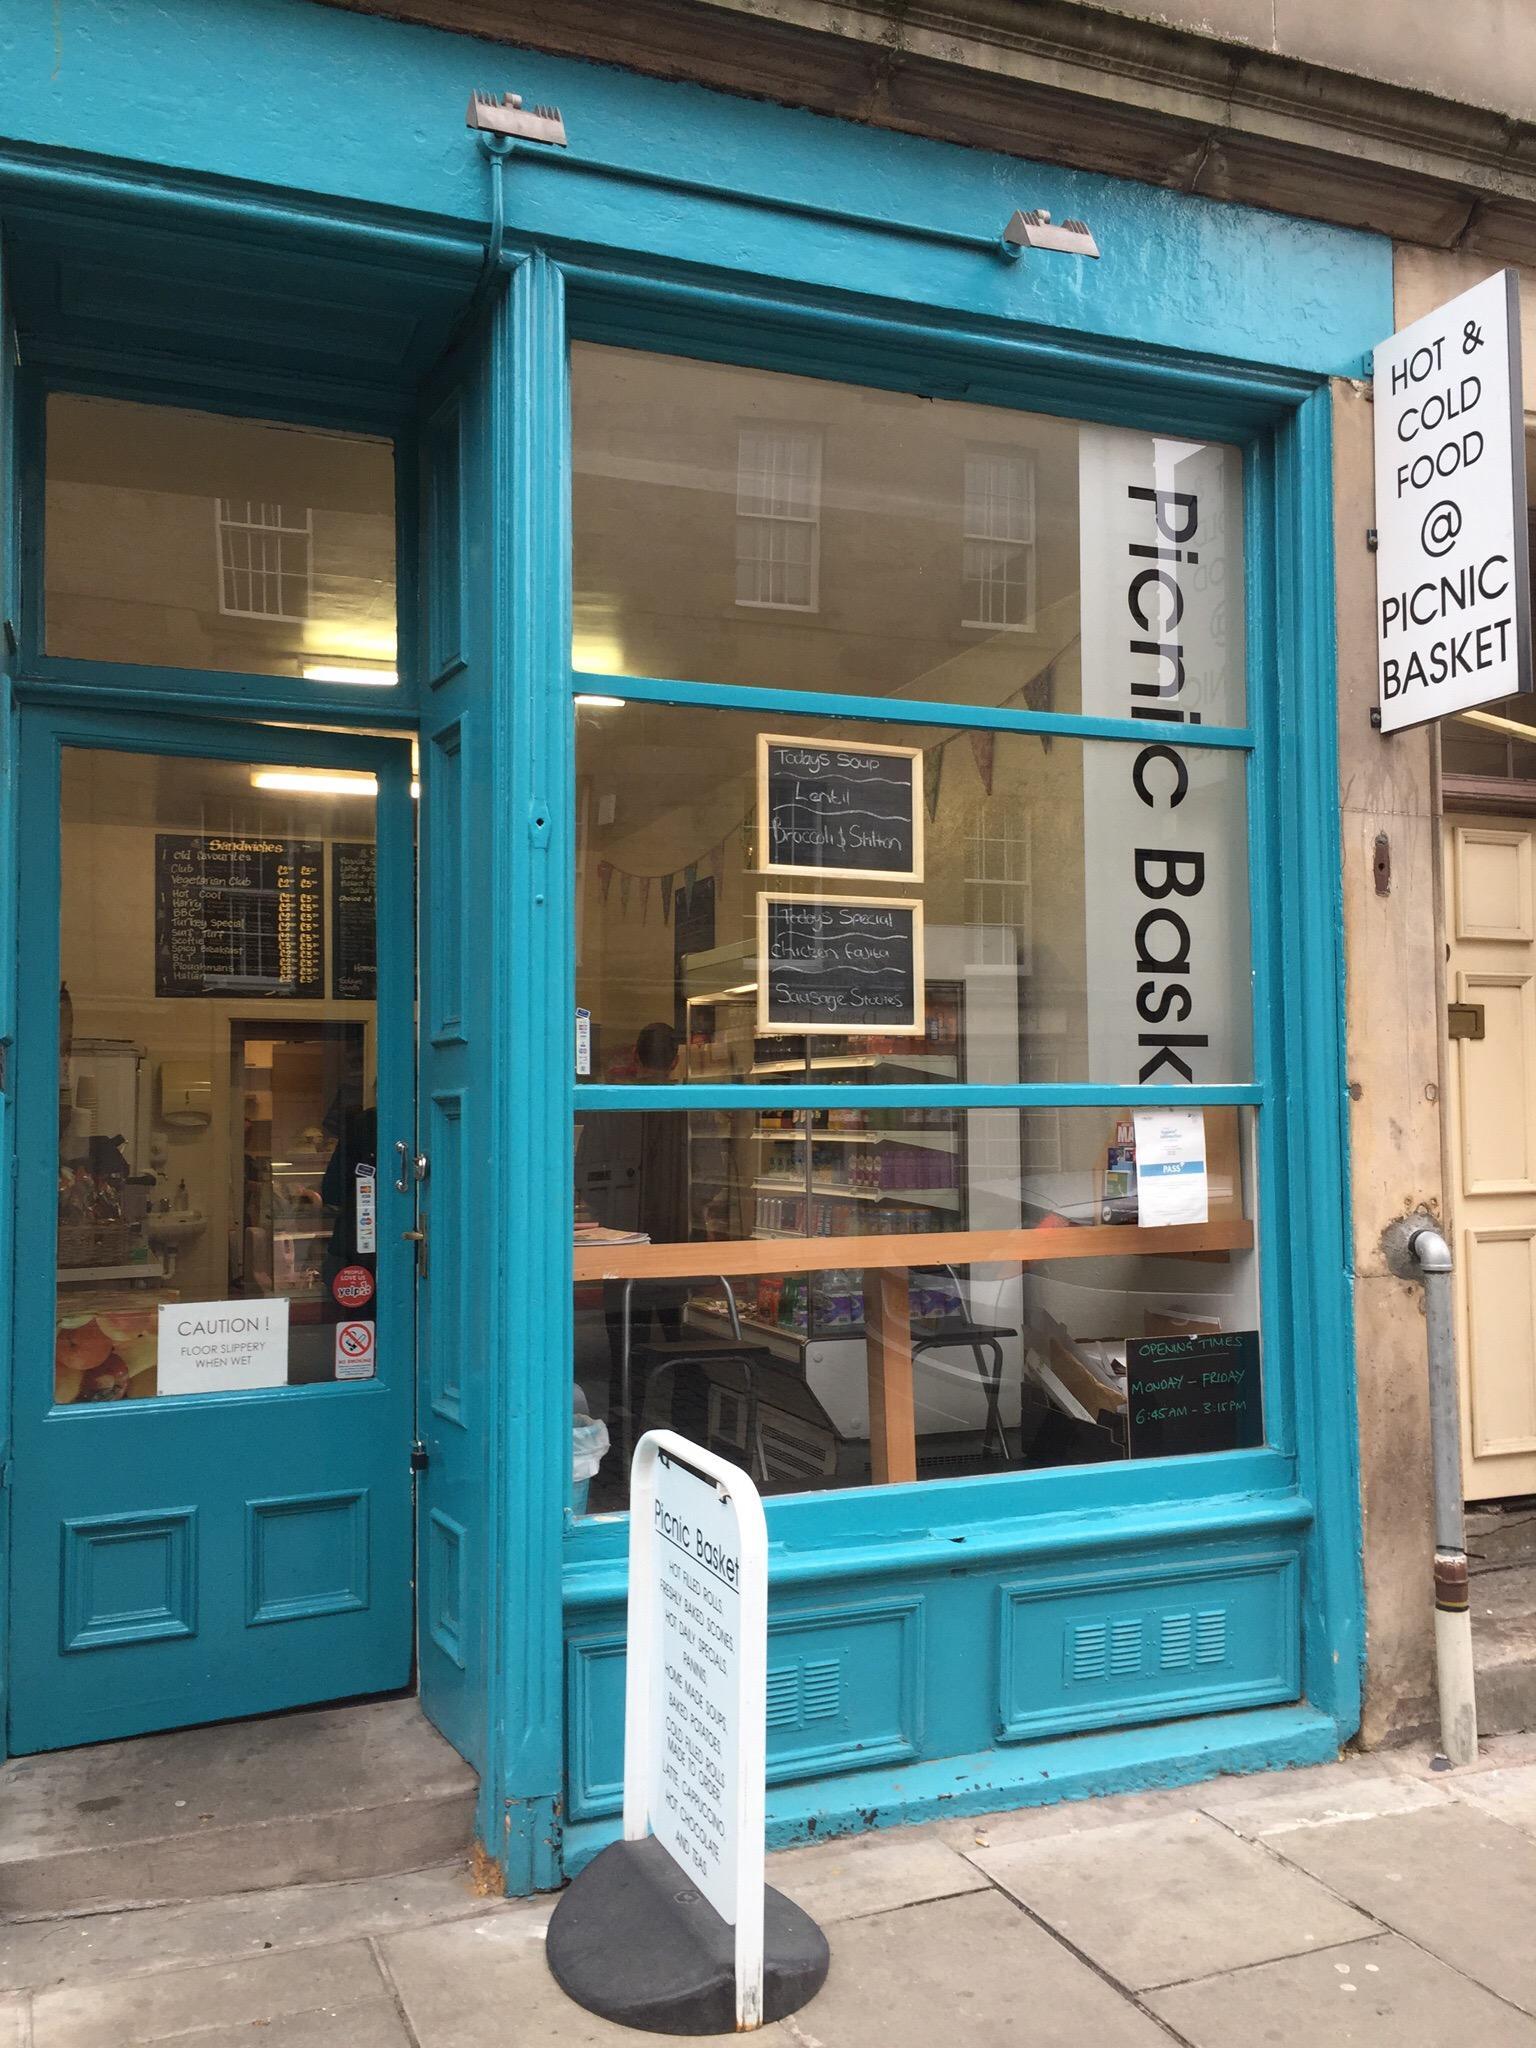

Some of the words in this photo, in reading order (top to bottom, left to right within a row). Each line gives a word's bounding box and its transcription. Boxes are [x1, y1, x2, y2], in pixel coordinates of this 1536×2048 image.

[1391, 336, 1446, 396] HOT
[1462, 320, 1485, 355] &
[1397, 375, 1482, 442] COLD
[1397, 430, 1484, 498] FOOD
[1421, 500, 1462, 557] @
[1382, 554, 1510, 638] PICNIC
[1128, 485, 1201, 809] Picnic
[1383, 617, 1512, 700] BASKET
[773, 749, 831, 773] Todays
[836, 753, 880, 771] Soup
[795, 781, 850, 805] Lentil
[772, 816, 834, 844] Broccoli
[849, 824, 902, 851] Stilton
[173, 849, 191, 861] Old
[209, 839, 284, 853] Sandwiches
[170, 863, 194, 874] Club
[170, 875, 226, 887] Vegetarian
[228, 876, 251, 887] Club
[172, 889, 190, 899] Hot
[172, 899, 201, 911] Harry
[171, 918, 208, 930] Turkey
[210, 918, 245, 930] Special
[173, 908, 195, 918] BBC
[781, 908, 834, 932] Todays
[839, 909, 893, 927] Special
[771, 941, 840, 960] Chicken
[173, 961, 235, 973] Ploughmans
[775, 983, 848, 1012] Sausage
[1162, 1163, 1181, 1174] PASS
[337, 1285, 361, 1298] yelp
[177, 1317, 260, 1337] CAUTION
[264, 1316, 270, 1331] !
[180, 1344, 218, 1357] FLOOR
[220, 1341, 266, 1354] SLIPPERY
[1138, 1341, 1194, 1357] OPENING
[1198, 1336, 1243, 1349] TIMES
[195, 1357, 228, 1369] WHEN
[232, 1355, 253, 1366] WET
[1131, 1375, 1184, 1395] MONDAY
[1201, 1369, 1246, 1388] FRIDAY
[655, 1498, 690, 1549] Picnic
[696, 1527, 740, 1587] Basket
[669, 1559, 681, 1580] HOT
[683, 1570, 701, 1595] FILLED
[684, 1598, 704, 1626] BAKED
[665, 1608, 677, 1629] HOT
[679, 1620, 696, 1645] DAILY
[665, 1661, 682, 1689] HOME
[684, 1680, 703, 1710] MADE
[669, 1691, 688, 1721] BAKED
[666, 1715, 683, 1743] COLD
[685, 1735, 703, 1764] FILLED
[705, 1756, 725, 1789] ROLLS
[667, 1736, 686, 1767] MADE
[688, 1756, 697, 1777] TO
[665, 1788, 679, 1812] HOT
[676, 1829, 690, 1855] AND
